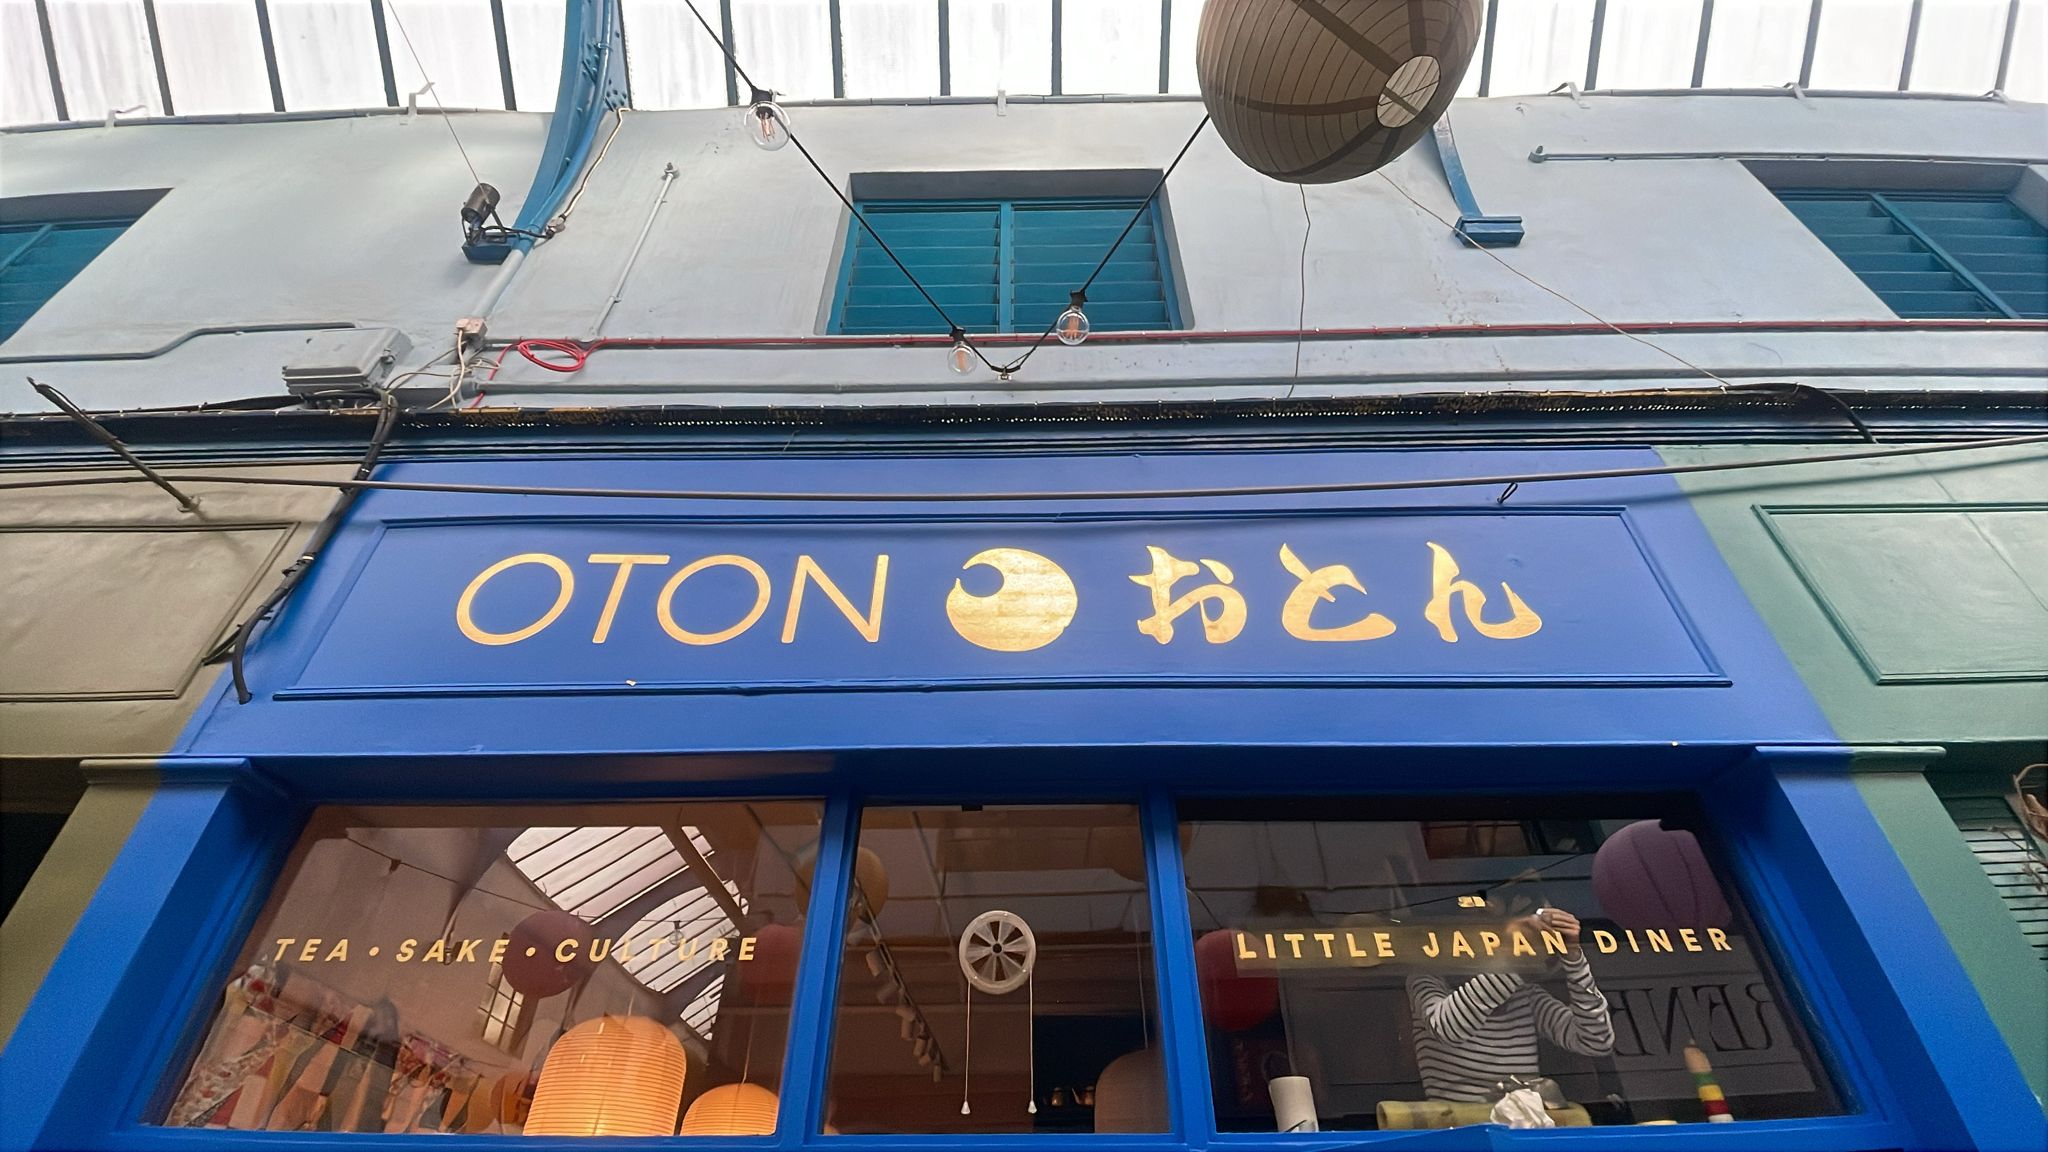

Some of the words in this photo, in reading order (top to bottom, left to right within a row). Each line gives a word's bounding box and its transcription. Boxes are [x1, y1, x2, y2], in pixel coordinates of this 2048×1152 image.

[456, 553, 889, 646] OTON
[1129, 541, 1543, 645] おとん
[274, 938, 349, 962] TEA
[396, 938, 510, 963] SAKE
[554, 937, 757, 963] CULTURE
[1236, 931, 1396, 960] LITTLE
[1422, 929, 1569, 958] JAPAN
[1592, 927, 1733, 954] DINER
